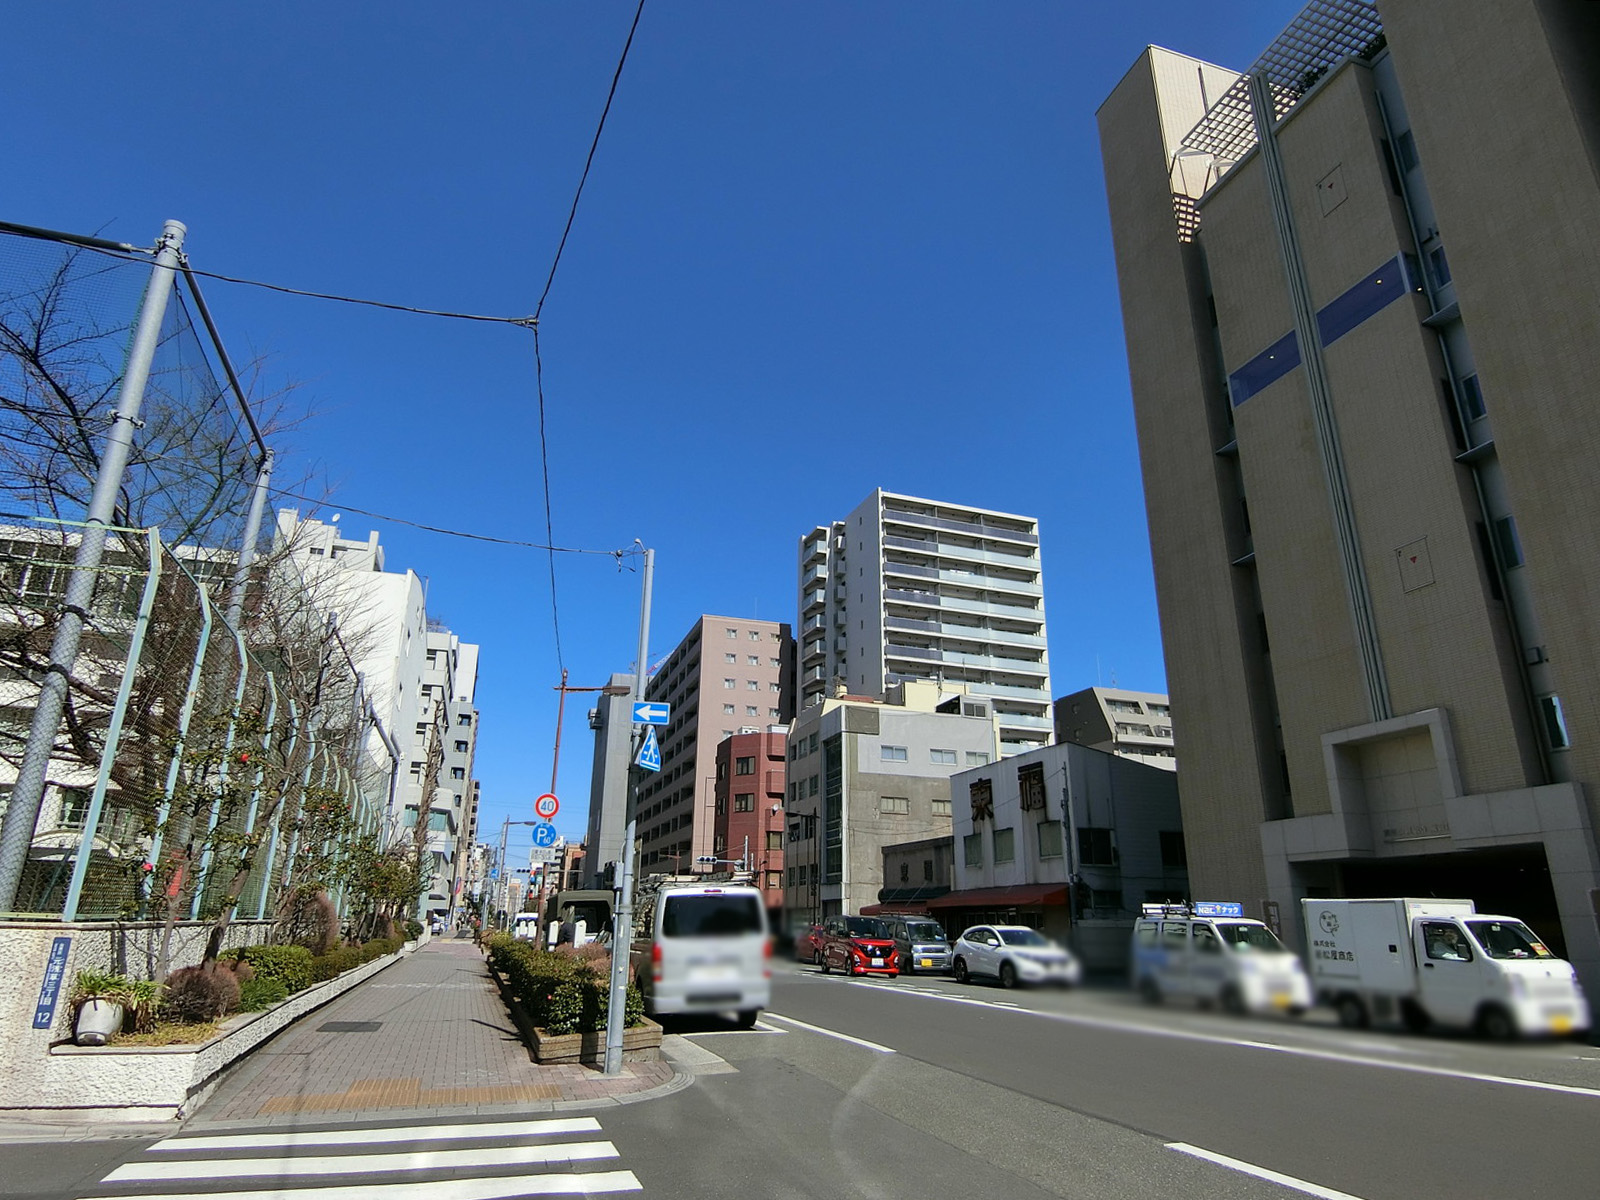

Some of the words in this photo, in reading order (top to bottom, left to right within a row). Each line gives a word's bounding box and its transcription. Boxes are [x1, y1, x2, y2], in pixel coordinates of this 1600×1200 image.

[540, 800, 555, 812] 40
[536, 827, 548, 844] P
[1222, 906, 1239, 914] ナック
[1313, 939, 1336, 948] 株式会社
[43, 956, 65, 1006] 元浅草三丁目
[36, 1012, 51, 1023] 12
